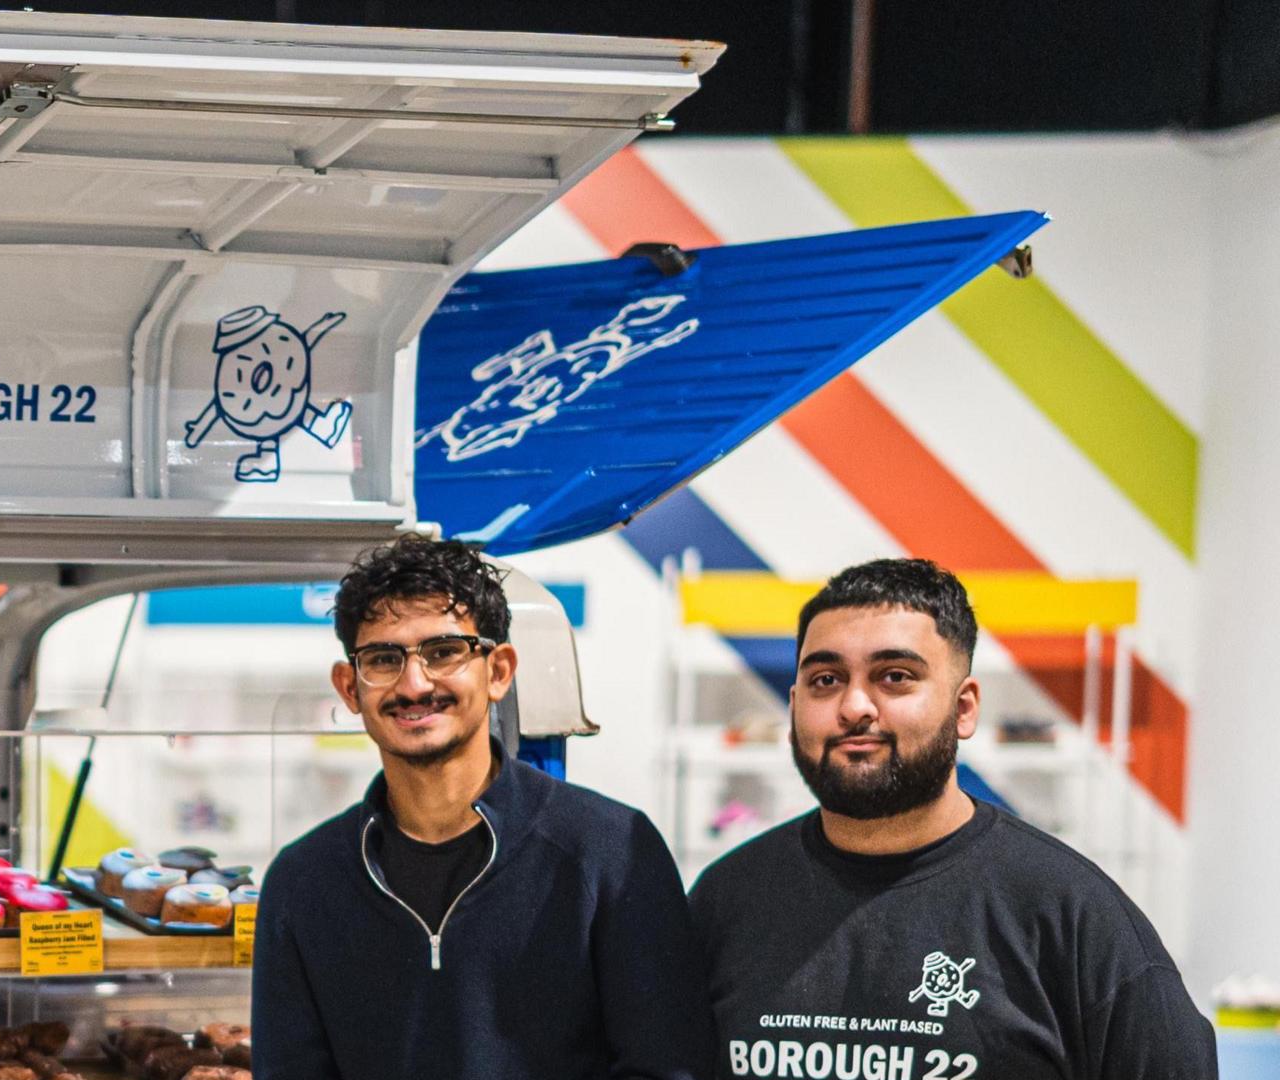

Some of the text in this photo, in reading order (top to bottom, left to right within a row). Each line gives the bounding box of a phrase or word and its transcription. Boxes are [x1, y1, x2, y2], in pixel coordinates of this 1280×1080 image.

[49, 383, 97, 424] 22
[759, 1014, 944, 1035] GLUTEN FREE & PLANT BASED
